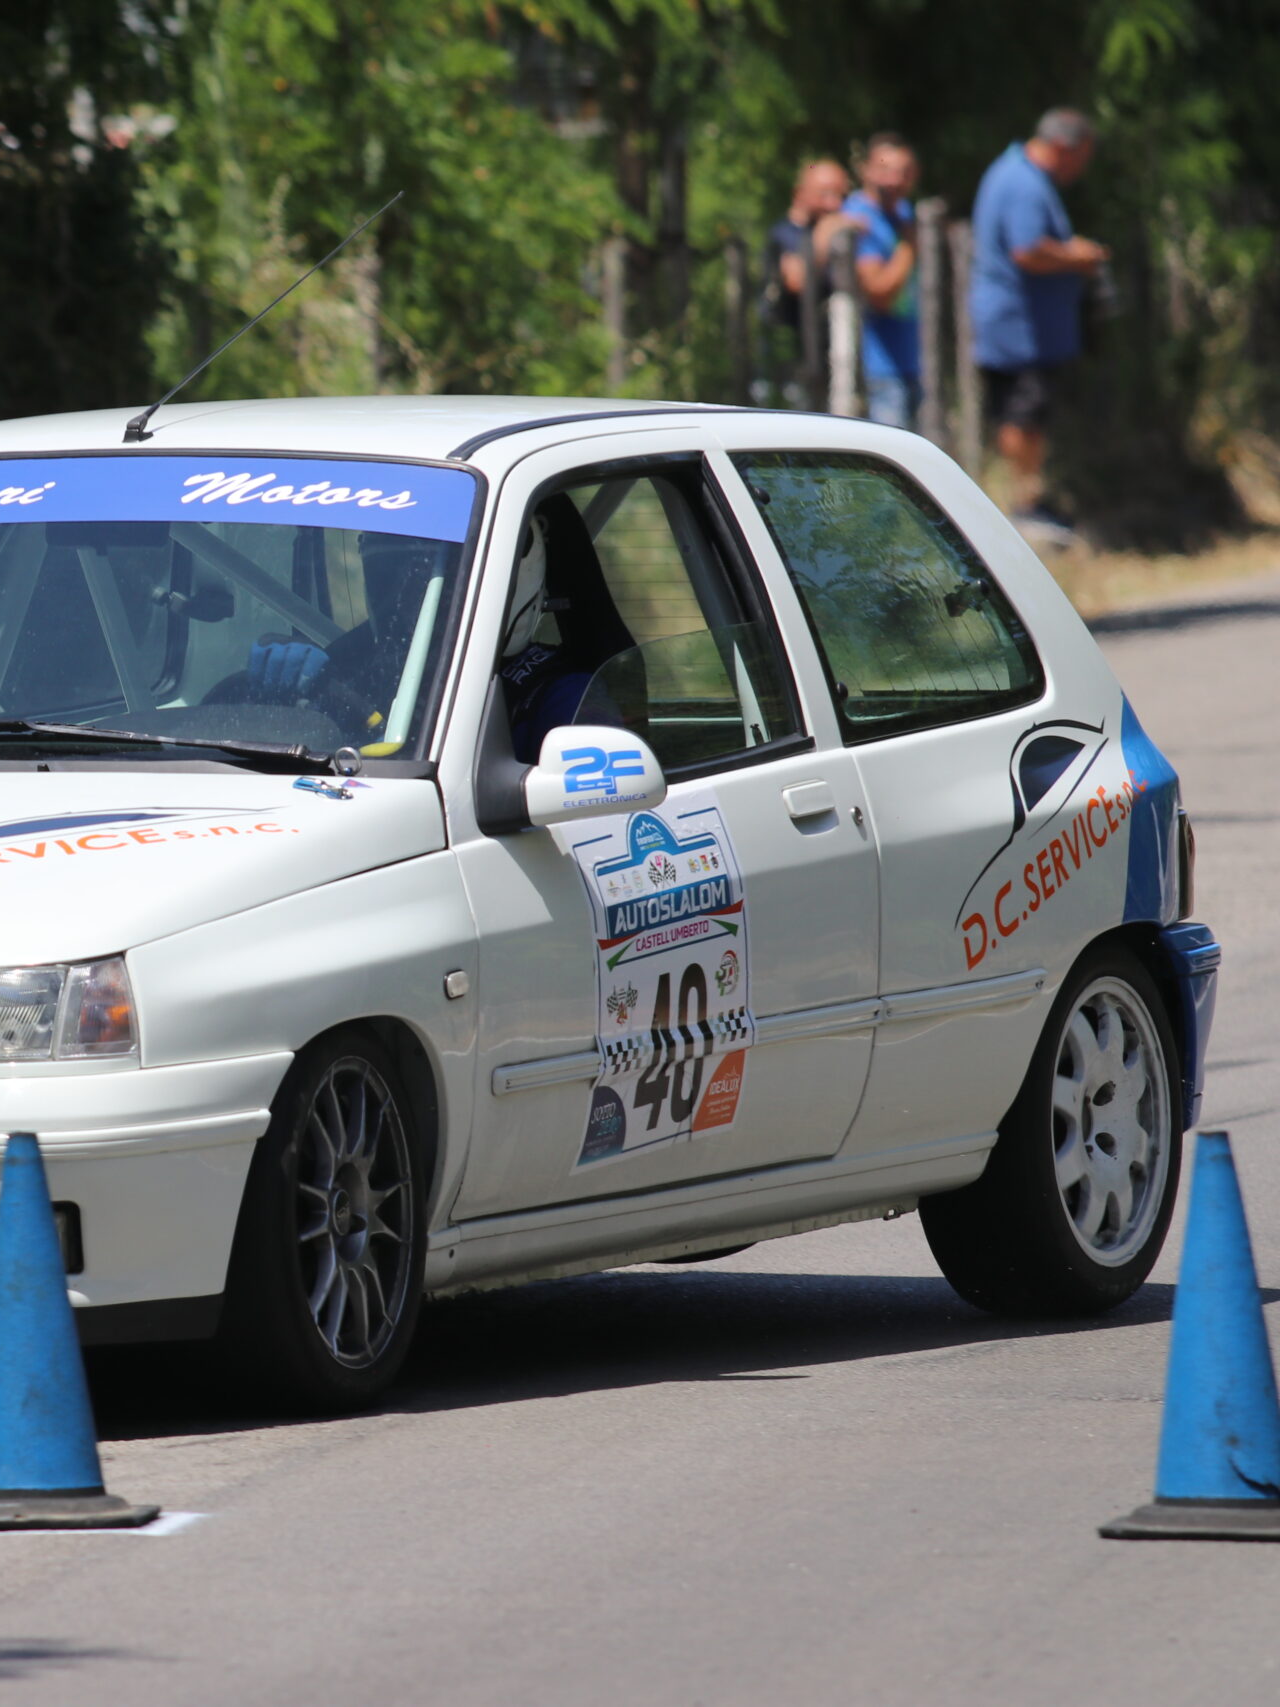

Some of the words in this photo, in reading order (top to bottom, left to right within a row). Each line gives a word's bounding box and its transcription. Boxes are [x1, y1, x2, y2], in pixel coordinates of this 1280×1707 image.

[181, 471, 419, 511] Motors
[563, 793, 648, 808] ELETTRONICA
[614, 879, 727, 935] AUTOSLALOM
[633, 963, 714, 1131] 40
